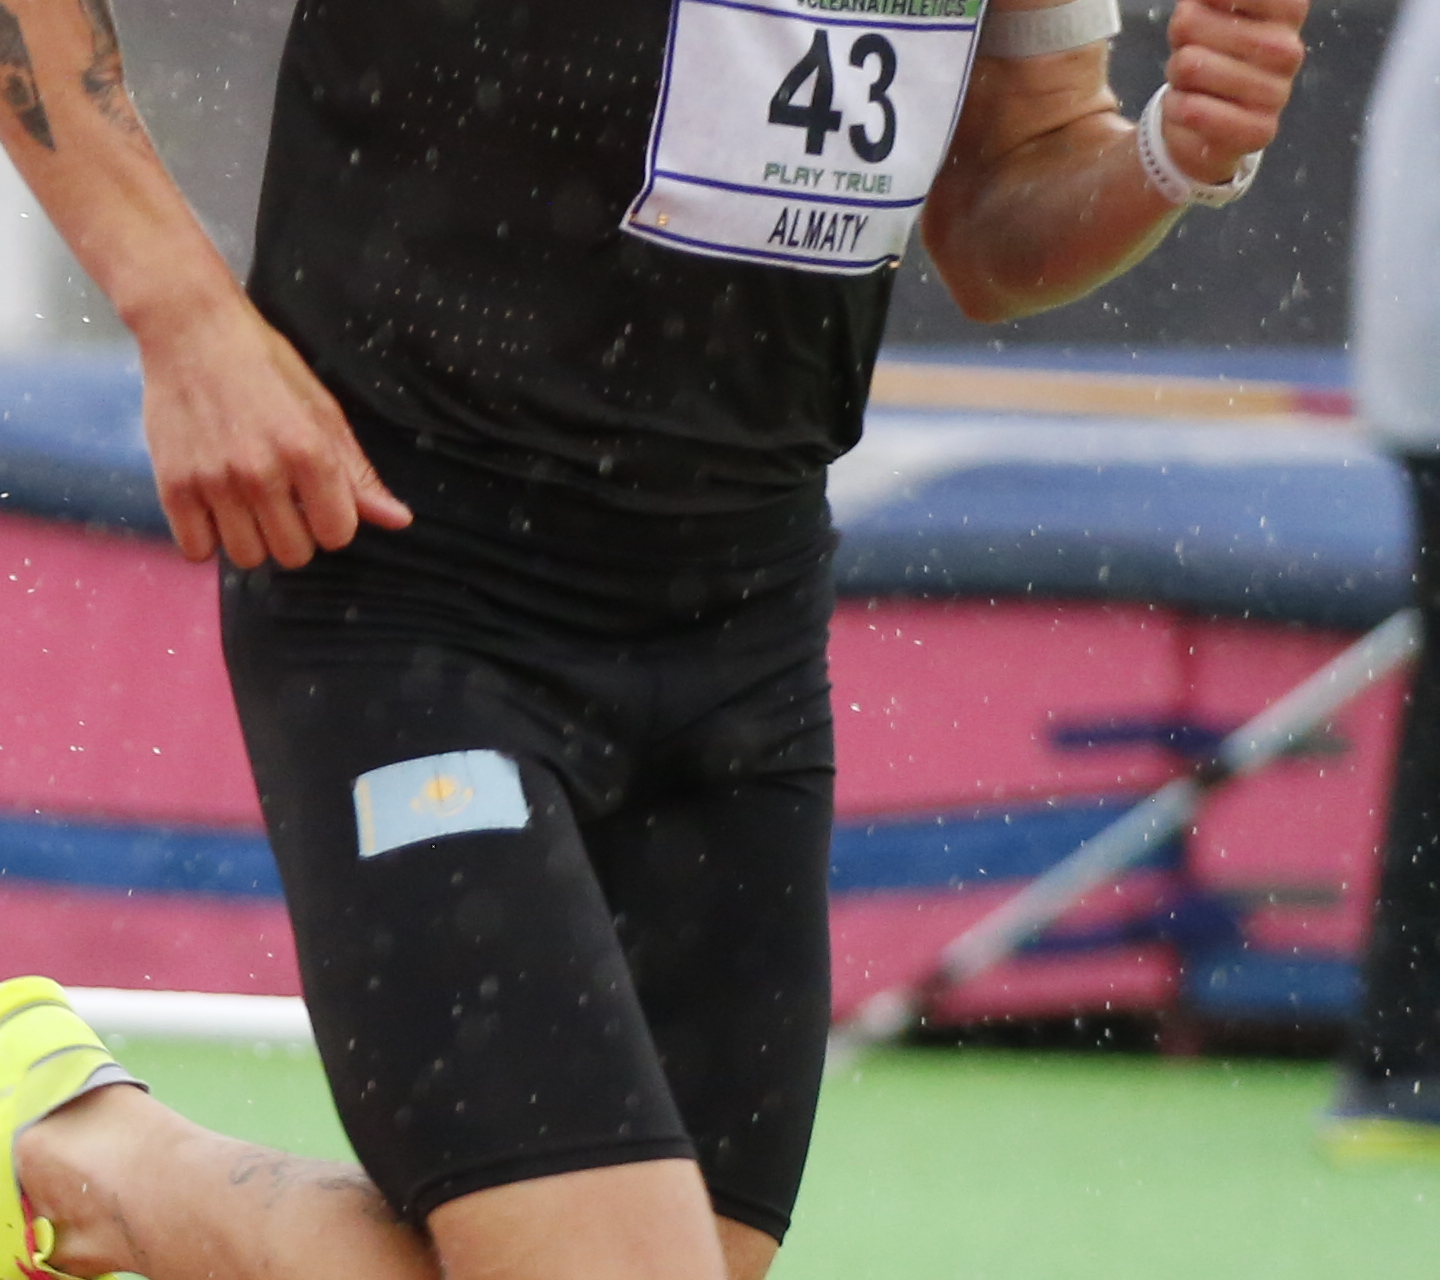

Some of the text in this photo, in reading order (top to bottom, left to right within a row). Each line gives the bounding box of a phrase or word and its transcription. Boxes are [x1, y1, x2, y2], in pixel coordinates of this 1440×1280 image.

[768, 29, 897, 163] 43
[763, 163, 824, 188] PLAY
[767, 207, 869, 253] ALMATY
